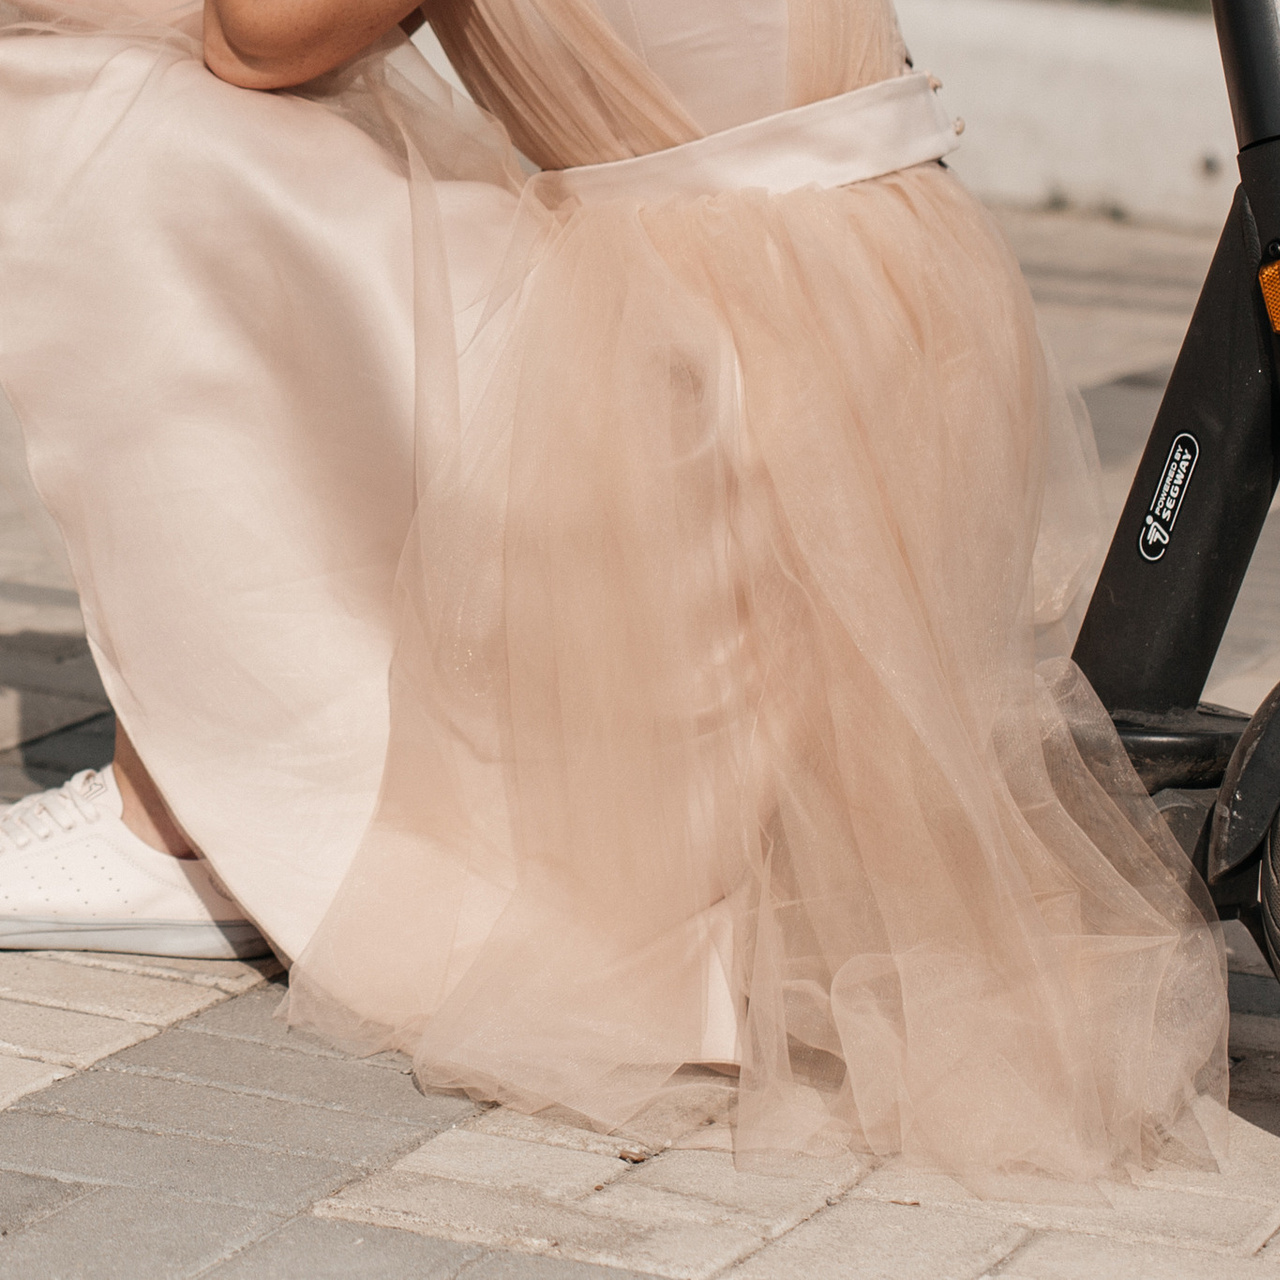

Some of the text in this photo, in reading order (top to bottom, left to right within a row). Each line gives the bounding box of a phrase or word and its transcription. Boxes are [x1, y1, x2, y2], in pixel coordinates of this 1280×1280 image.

[1155, 444, 1183, 516] POWERED BY
[1162, 448, 1192, 522] SEGWAY
